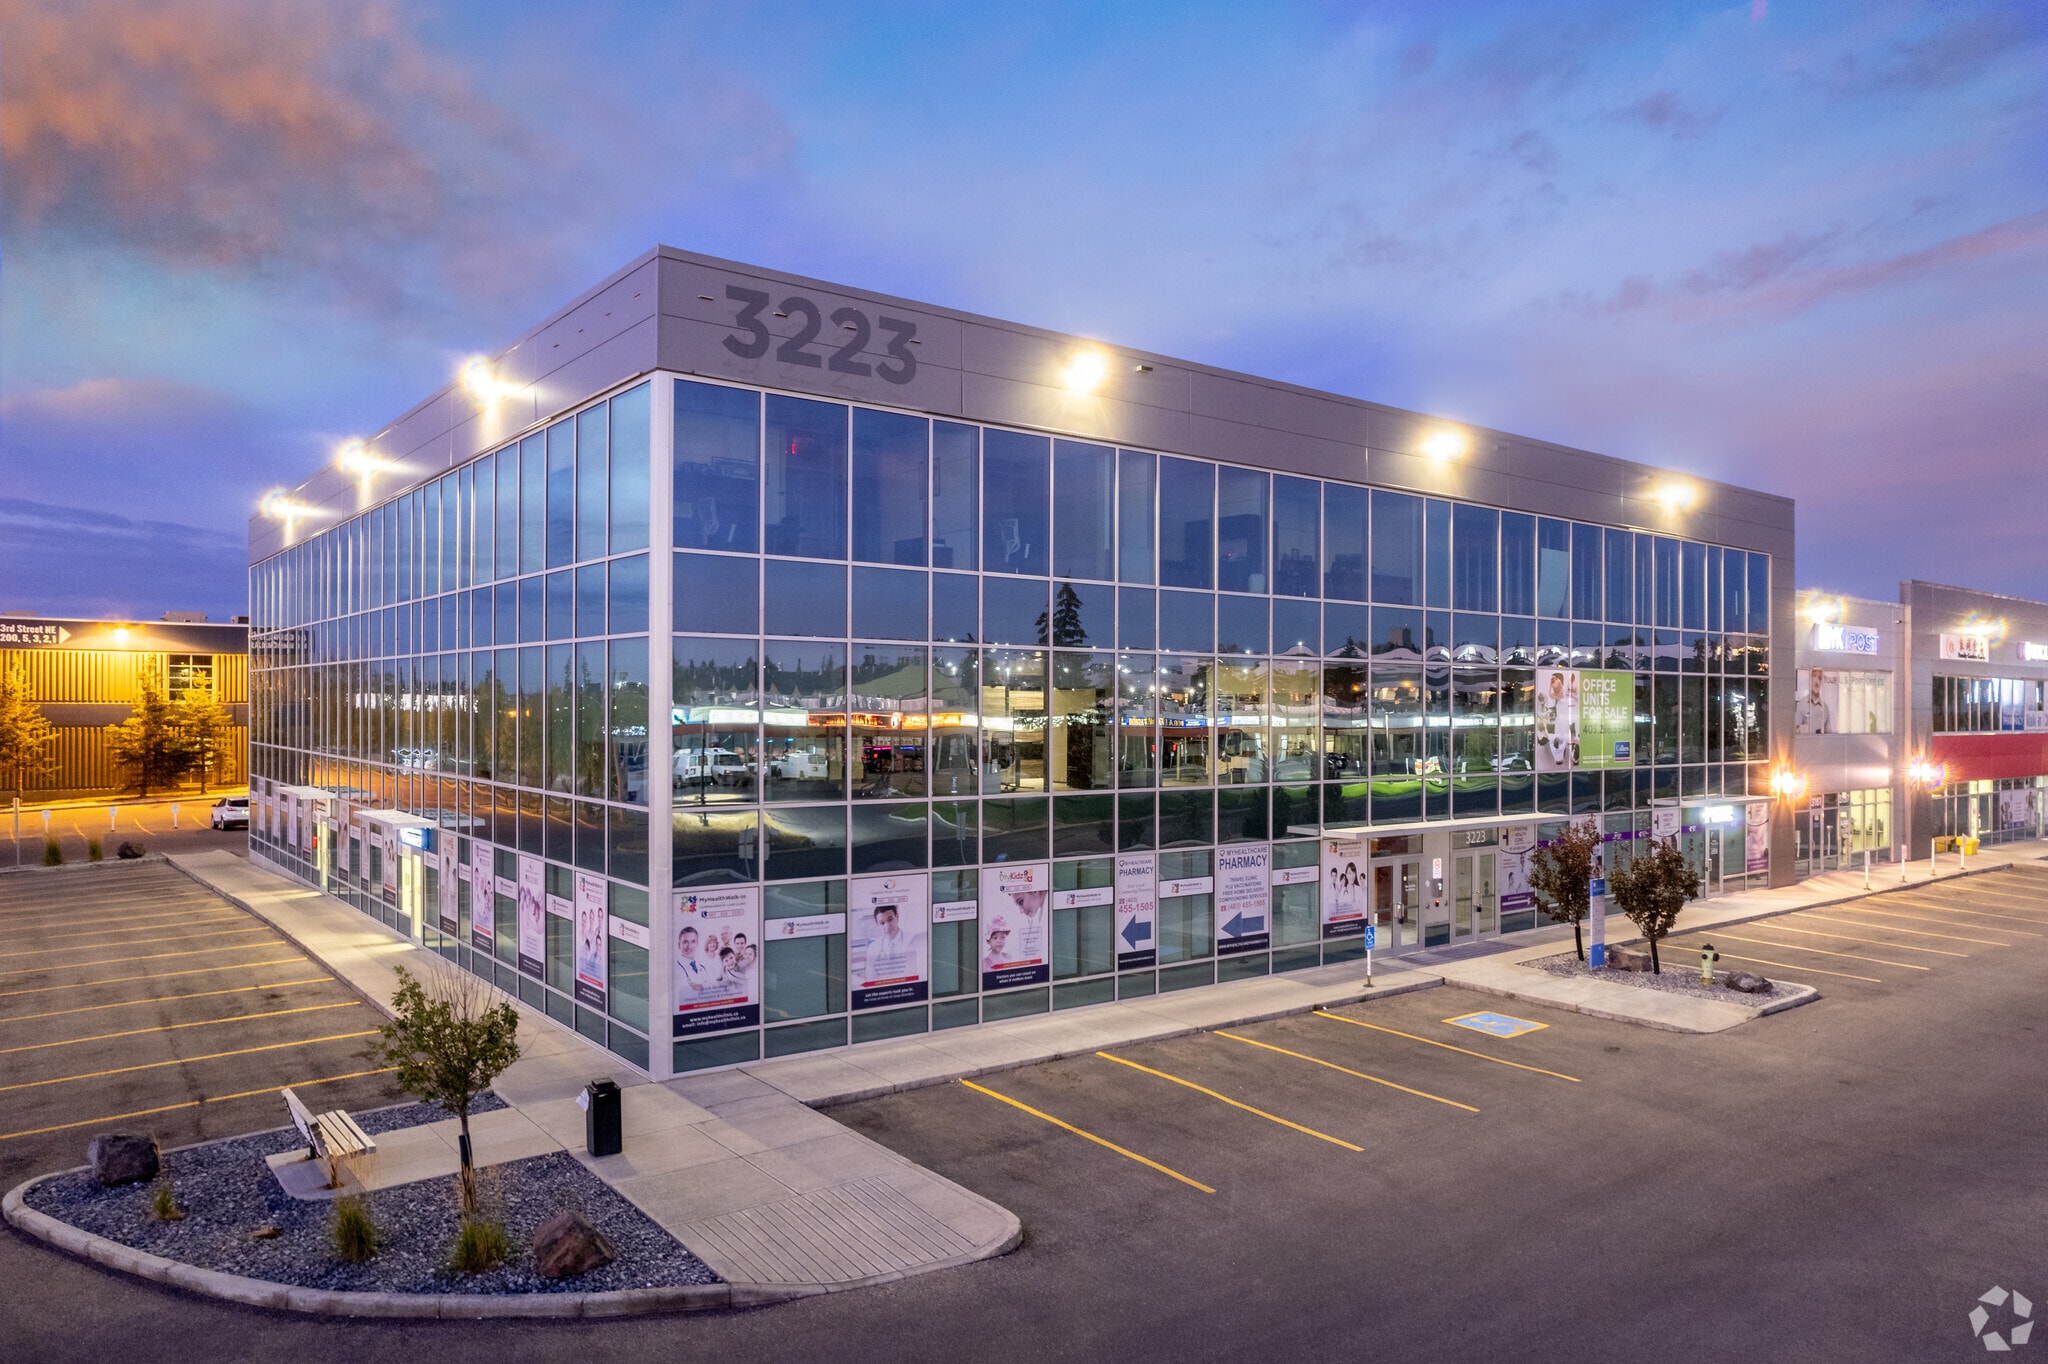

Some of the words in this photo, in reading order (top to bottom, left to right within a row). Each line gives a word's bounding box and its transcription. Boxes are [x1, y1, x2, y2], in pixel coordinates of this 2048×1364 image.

[721, 284, 918, 386] 3223
[1848, 632, 1880, 652] POST
[1582, 678, 1617, 692] OFFICE
[1582, 692, 1610, 706] UNITS
[1582, 706, 1603, 719] FOR
[1604, 707, 1628, 719] SALE
[1465, 830, 1486, 844] 3223
[1219, 854, 1267, 870] PHARMACY
[1119, 866, 1154, 876] PHARMACY
[1118, 902, 1154, 913] 455-1505
